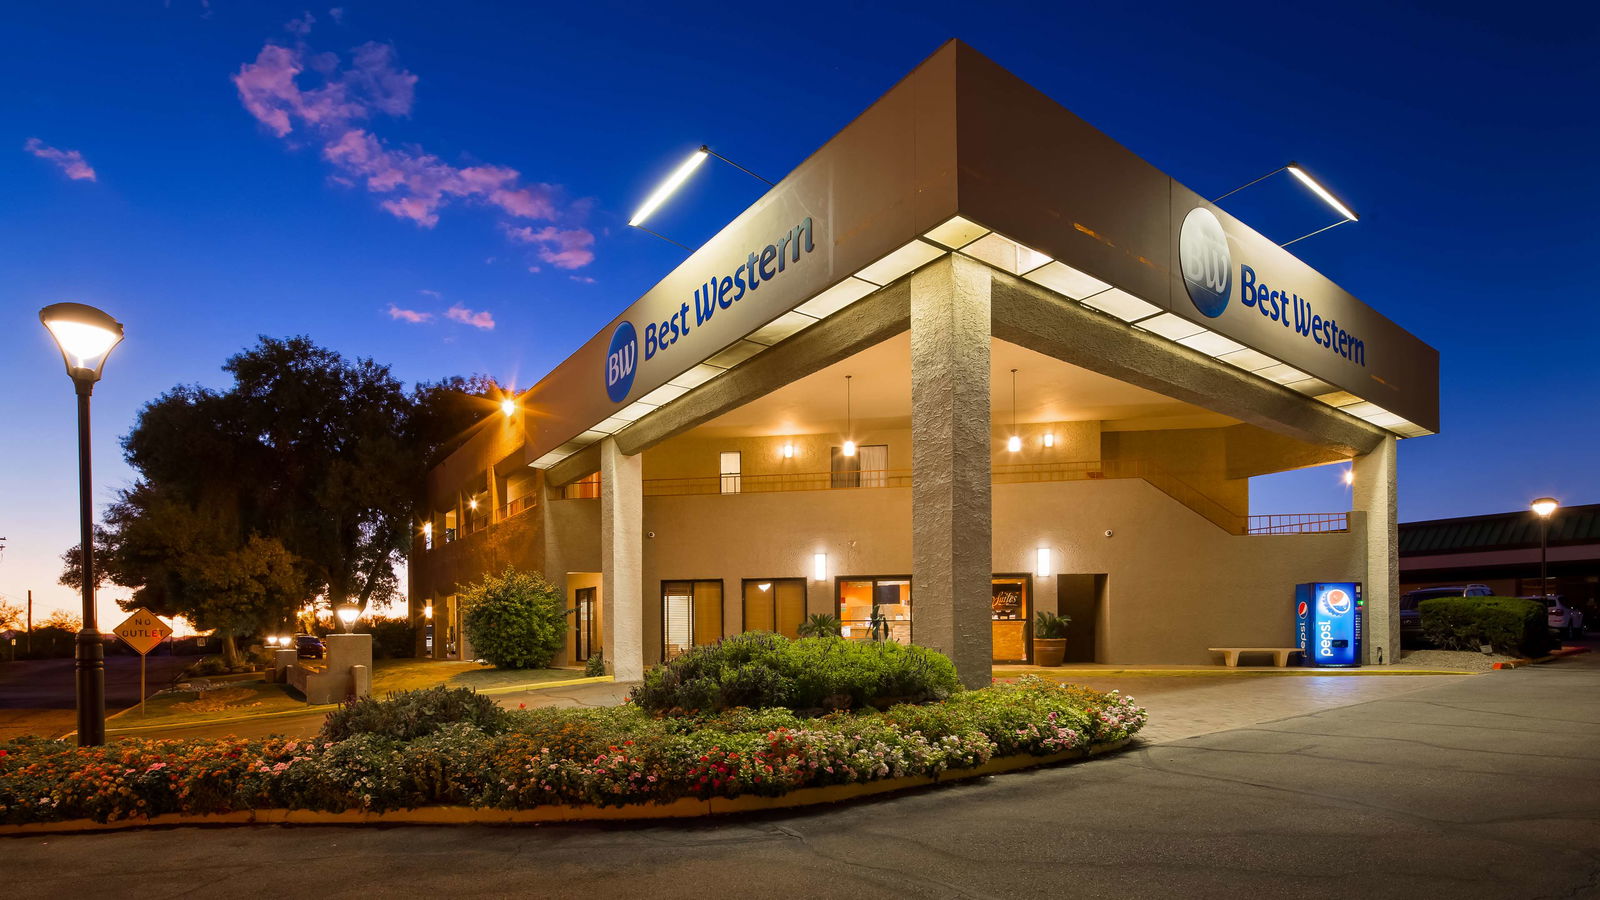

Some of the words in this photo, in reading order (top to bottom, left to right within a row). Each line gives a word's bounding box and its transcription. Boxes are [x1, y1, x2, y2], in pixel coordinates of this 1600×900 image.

[644, 302, 690, 362] Best
[693, 216, 816, 328] Western
[1186, 239, 1228, 294] BW
[1240, 263, 1290, 328] Best
[1292, 293, 1366, 368] Western
[608, 340, 635, 388] BW
[122, 629, 164, 638] OUTLET
[135, 618, 151, 626] NO
[1318, 620, 1334, 657] pepsi
